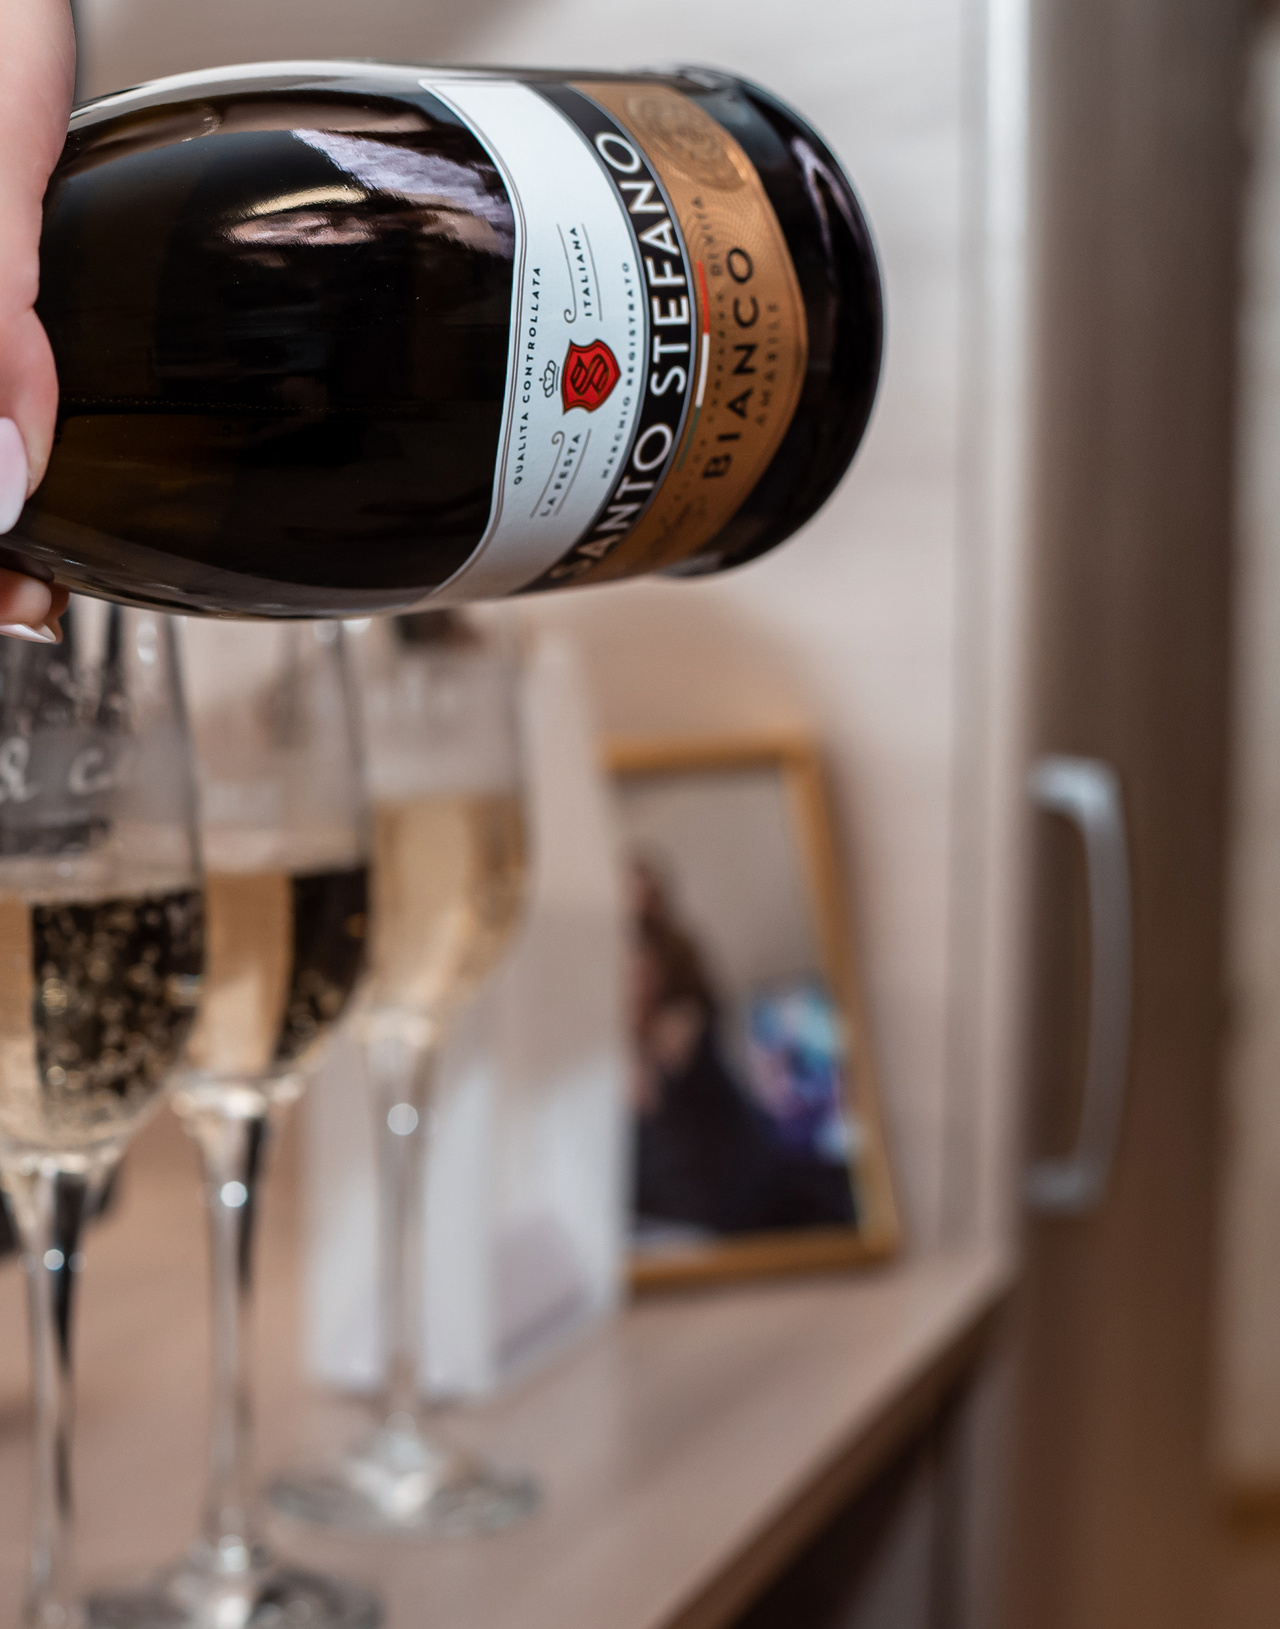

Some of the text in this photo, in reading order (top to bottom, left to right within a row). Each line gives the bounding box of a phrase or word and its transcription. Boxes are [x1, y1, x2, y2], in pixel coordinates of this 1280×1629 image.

[570, 226, 592, 318] ITALIANA
[594, 131, 692, 397] STEFANO
[601, 261, 637, 480] MARCHIO REGISTRATO
[702, 247, 759, 480] BIANCO
[513, 266, 541, 486] QUALITA CONTROLLATA
[539, 432, 582, 518] LA FESTA
[549, 422, 674, 579] SANTO
